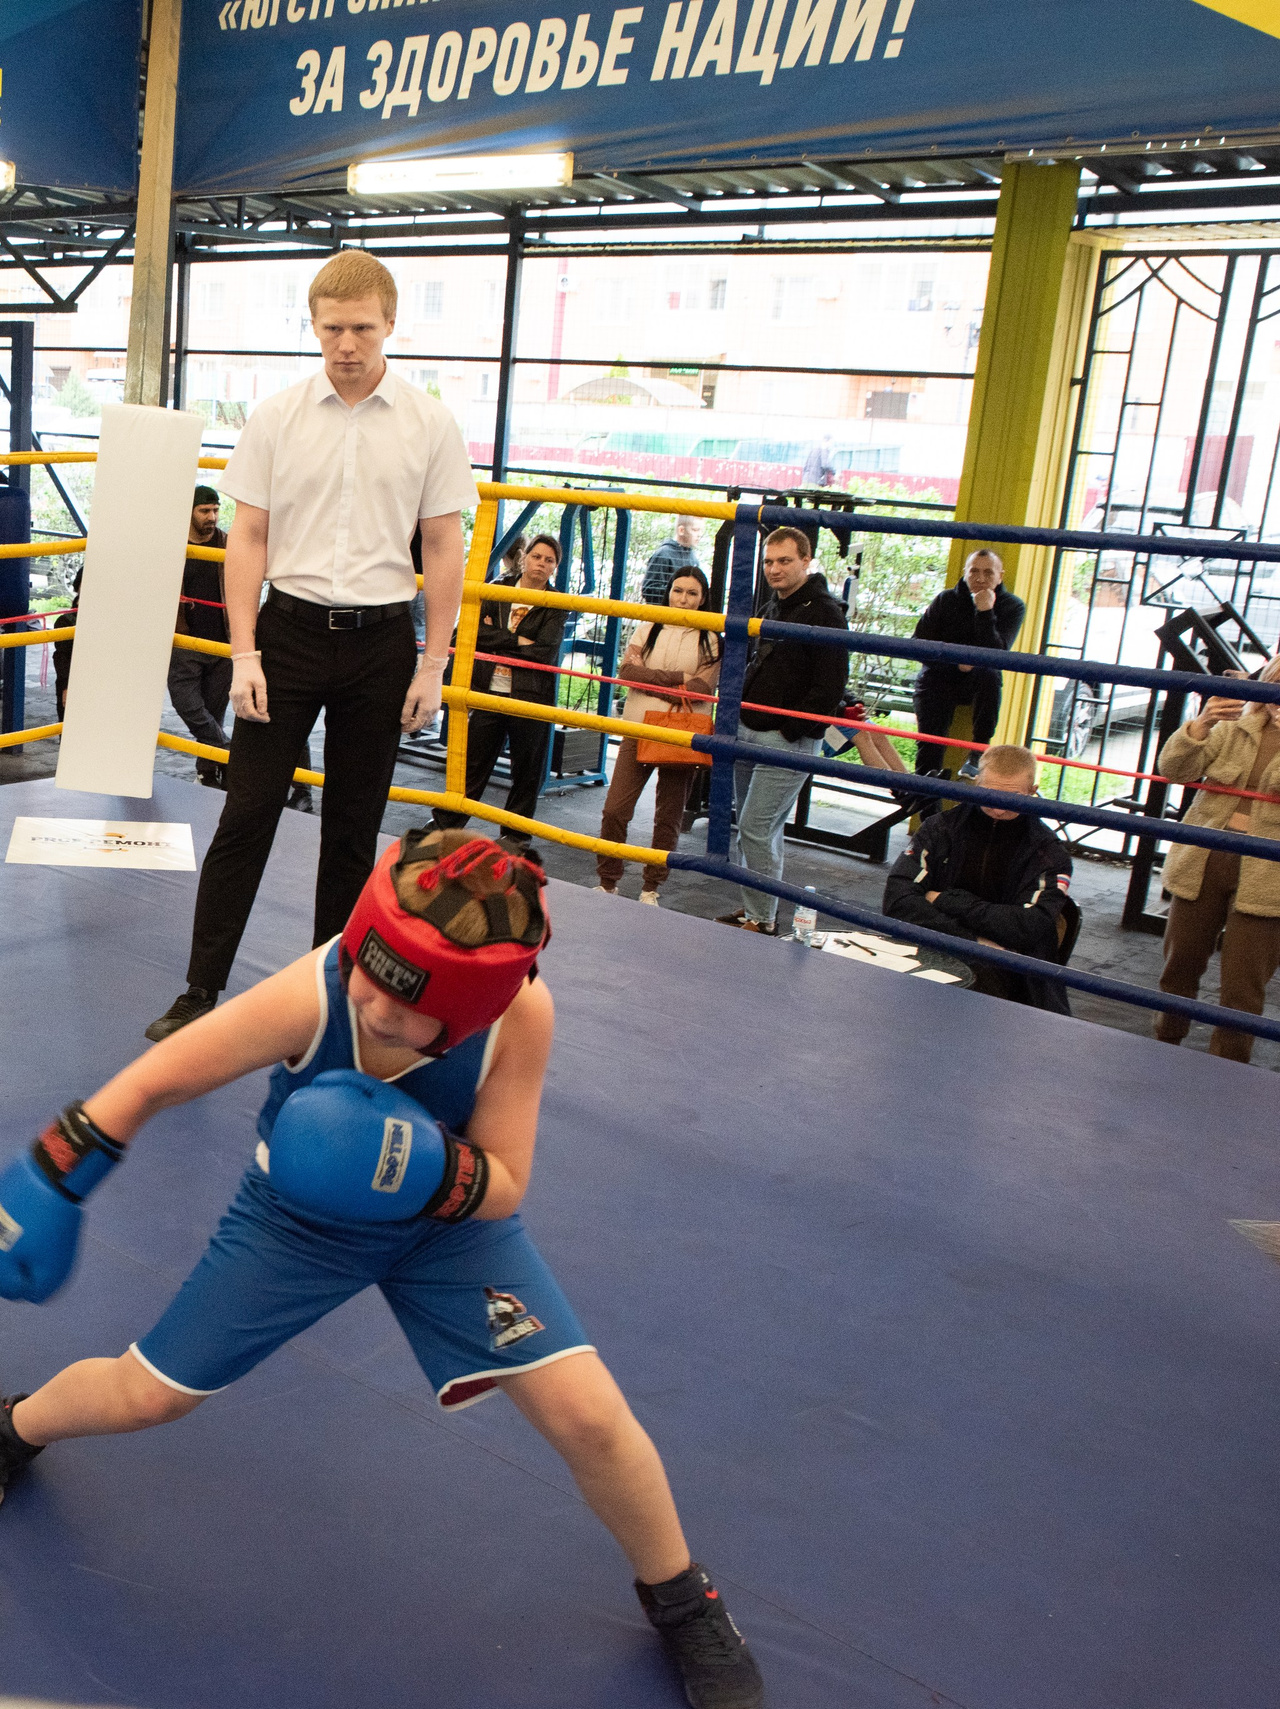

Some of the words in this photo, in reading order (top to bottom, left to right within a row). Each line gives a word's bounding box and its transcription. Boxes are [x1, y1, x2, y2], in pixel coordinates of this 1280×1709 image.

[289, 46, 345, 116] ЗА
[359, 8, 644, 120] ЗДОРОВЬЕ
[650, 0, 916, 86] НАЦИИ!
[389, 1123, 404, 1154] TEN
[380, 1155, 399, 1187] TOP
